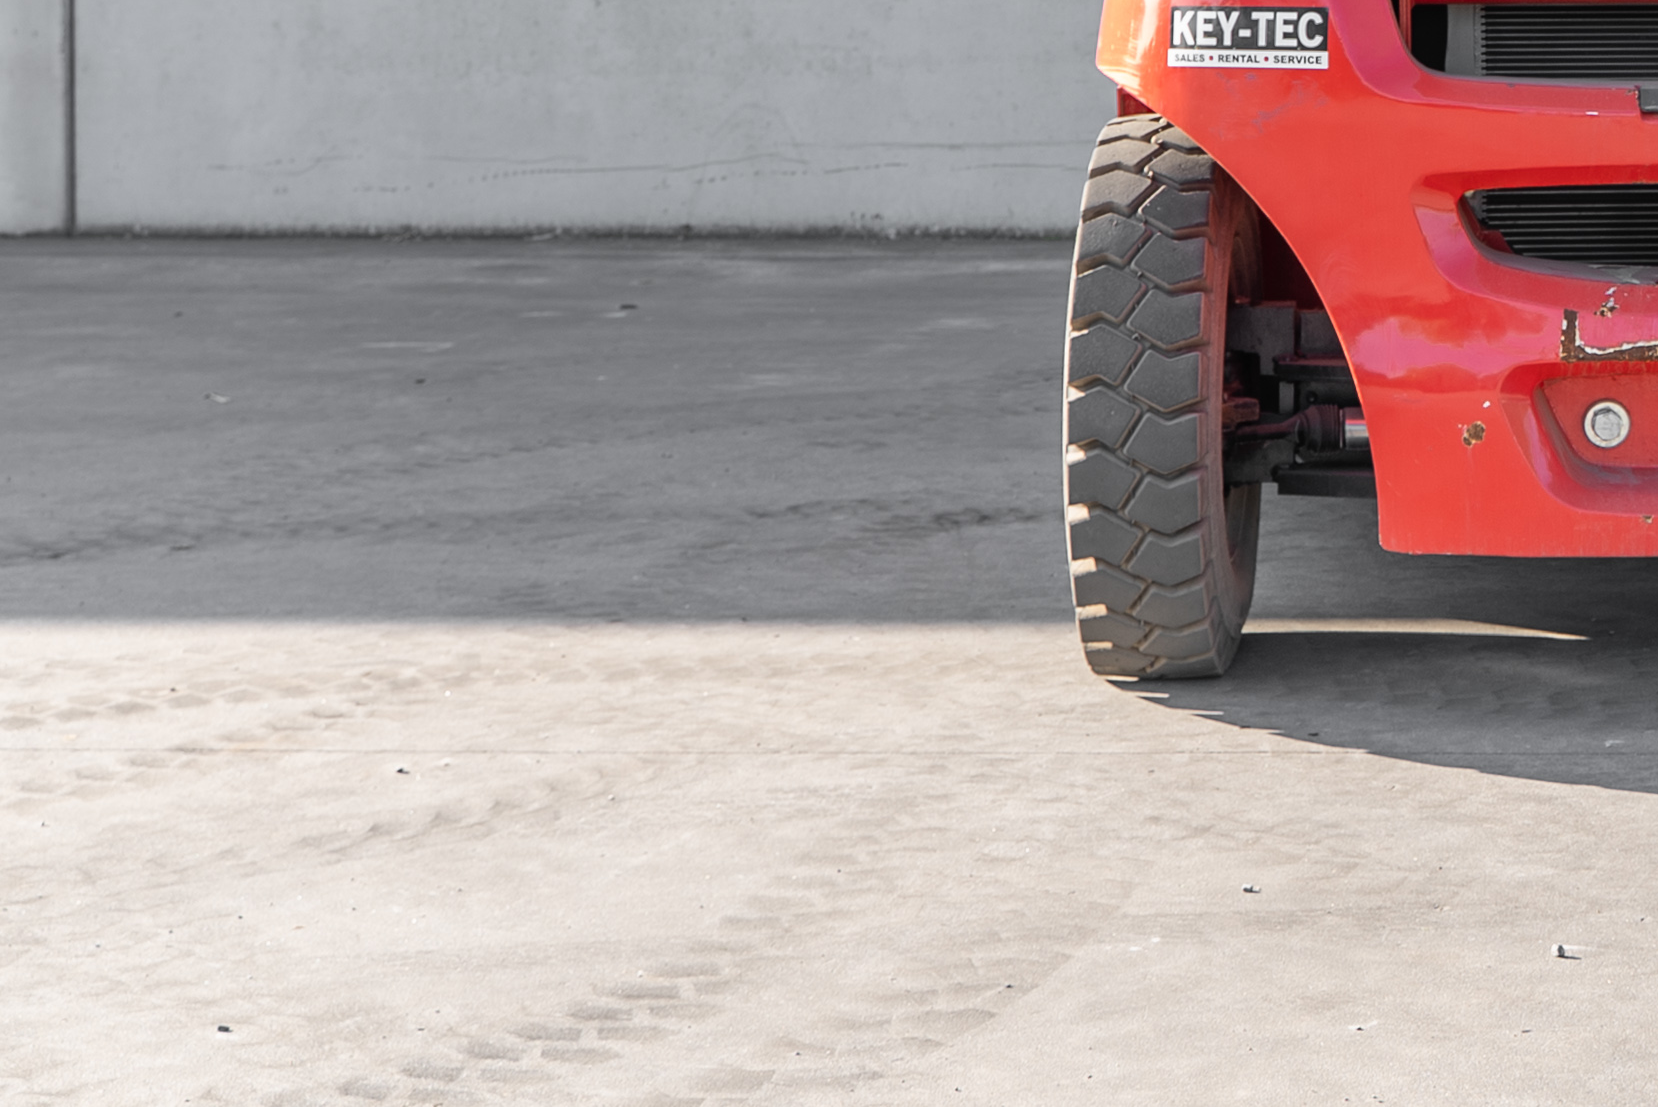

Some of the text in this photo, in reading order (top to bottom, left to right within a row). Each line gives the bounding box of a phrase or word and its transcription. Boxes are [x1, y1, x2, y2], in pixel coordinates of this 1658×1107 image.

[1172, 10, 1325, 48] KEY-TEC
[1174, 53, 1323, 65] SALES RENTAL SERVICE
